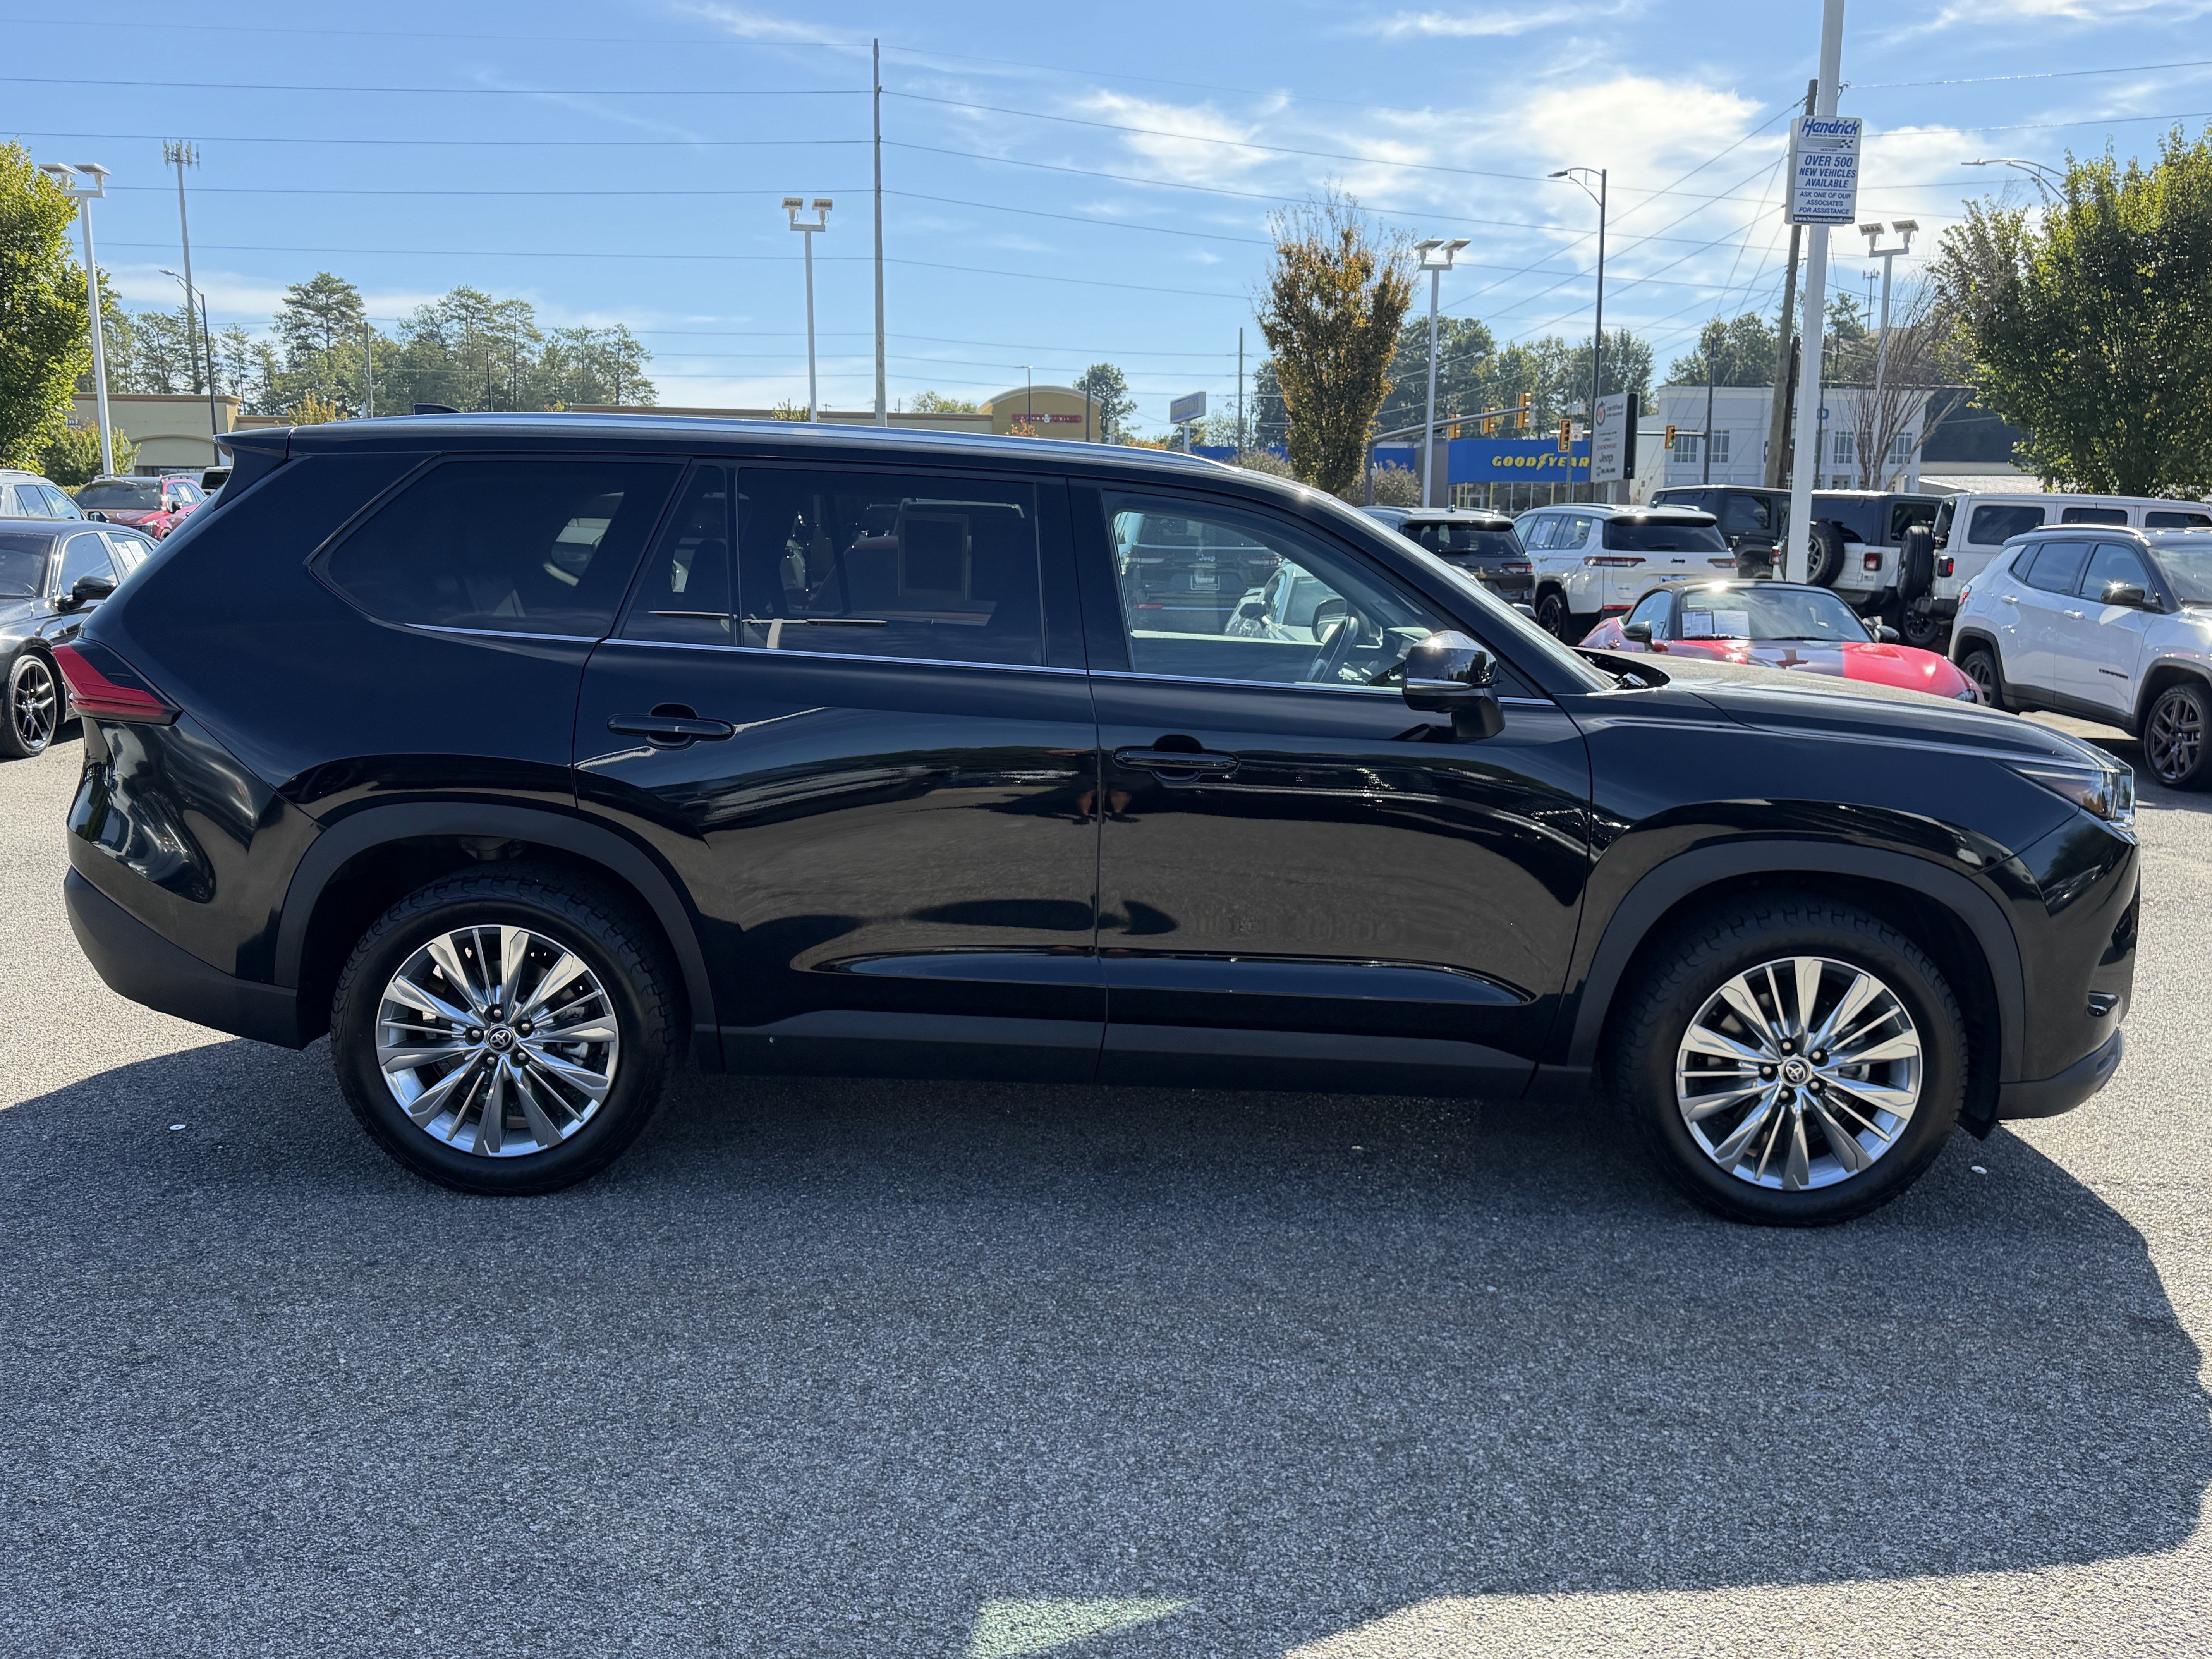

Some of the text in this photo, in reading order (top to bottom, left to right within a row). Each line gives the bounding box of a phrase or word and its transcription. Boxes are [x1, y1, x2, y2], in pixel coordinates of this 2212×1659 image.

[1801, 118, 1860, 137] Hendrick
[1805, 155, 1853, 167] OVER 500
[1799, 167, 1856, 178] NEW VEHICLES
[1805, 178, 1849, 188] AVAILABLE
[1599, 452, 1613, 464] Jeep
[1199, 553, 1216, 562] Jeep
